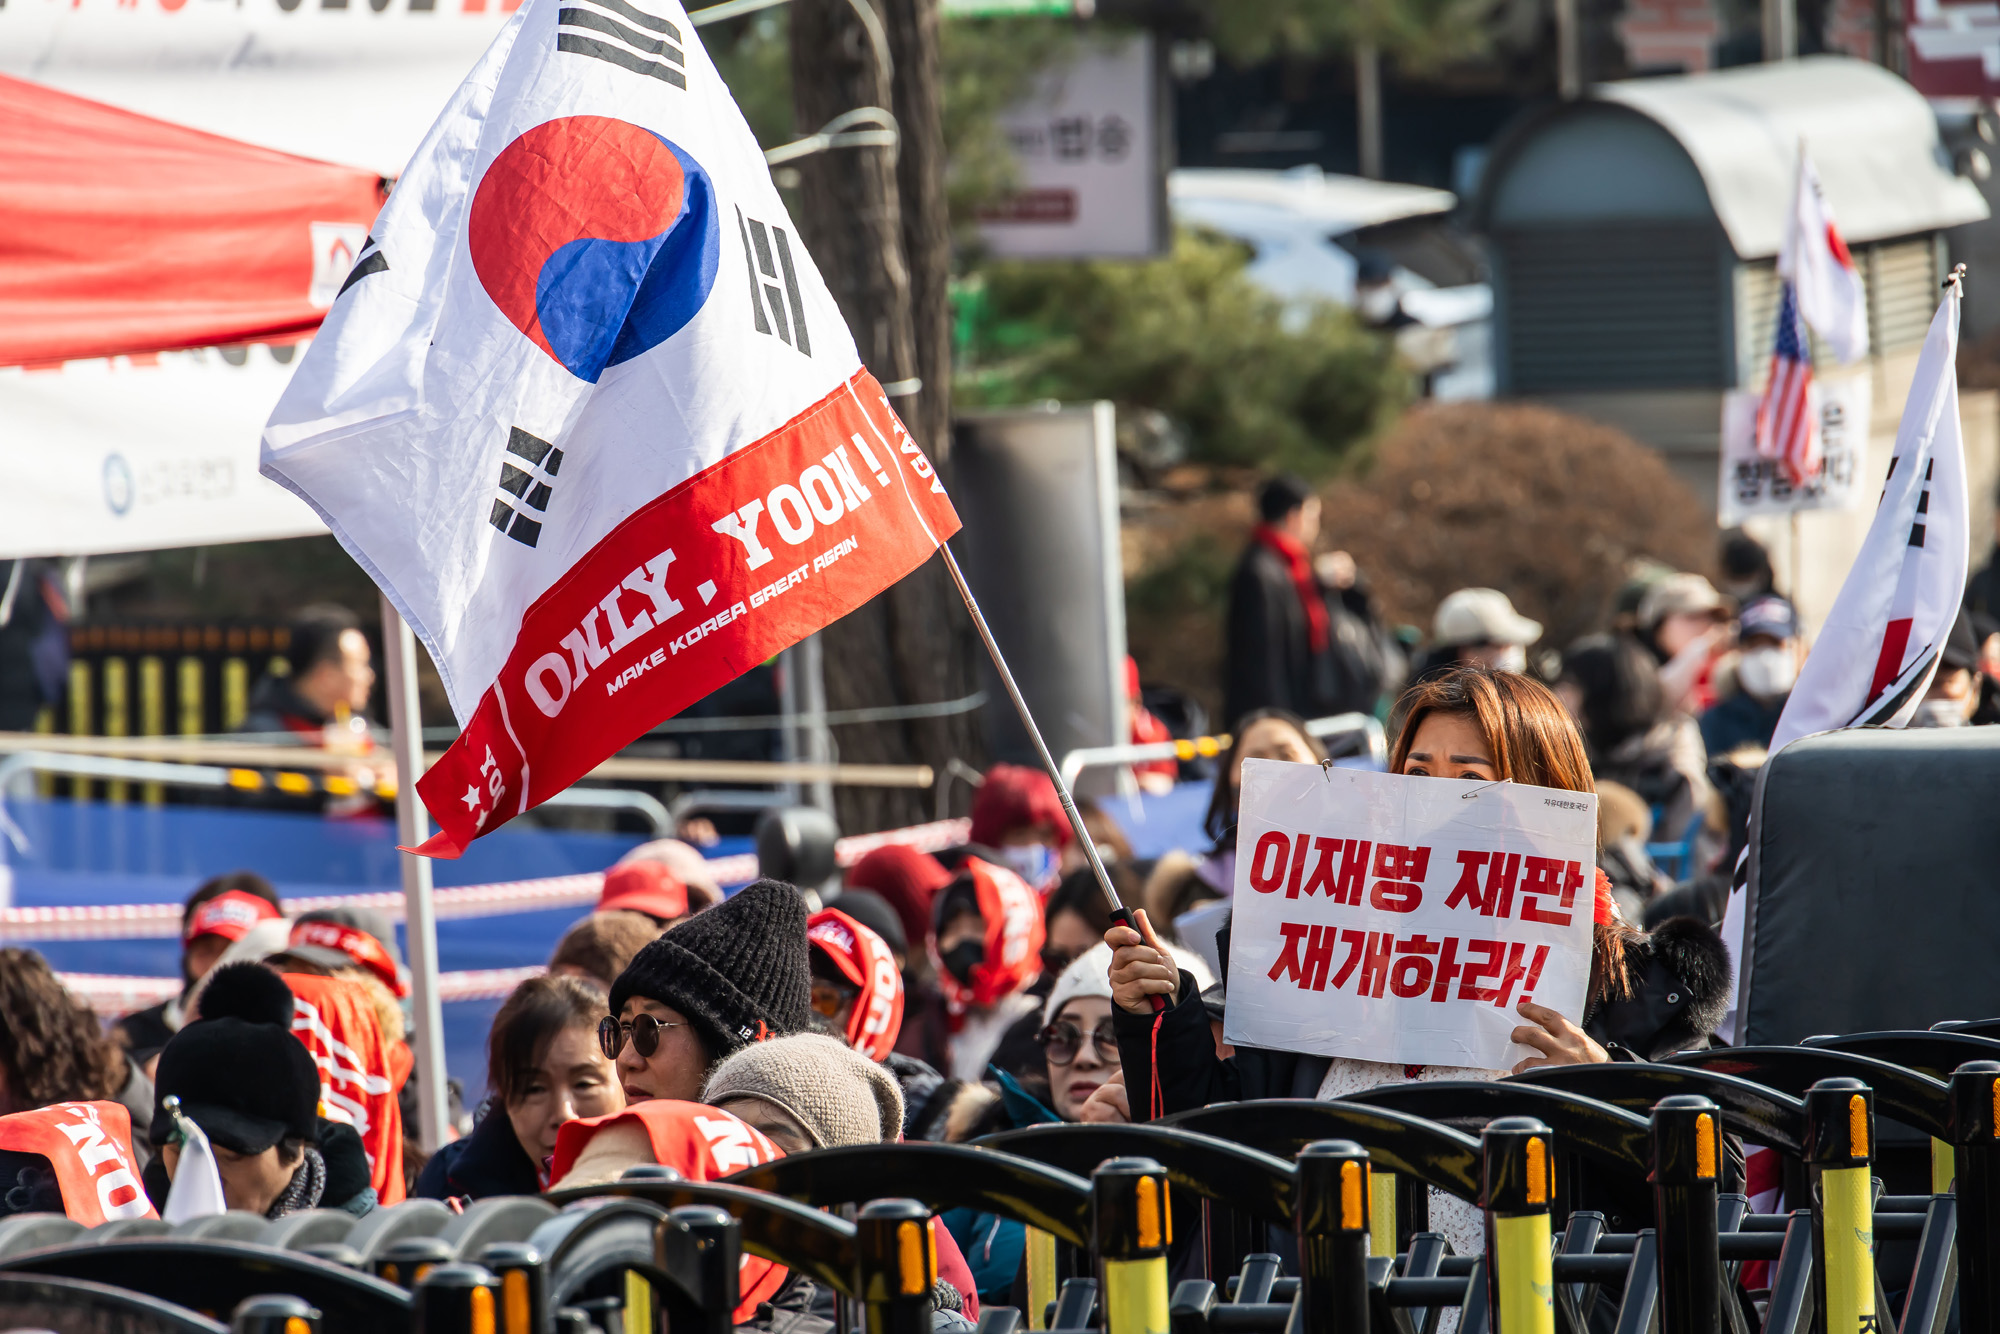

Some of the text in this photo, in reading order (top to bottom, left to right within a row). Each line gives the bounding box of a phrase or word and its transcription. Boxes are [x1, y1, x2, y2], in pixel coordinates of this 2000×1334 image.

[606, 535, 859, 696] MAKE KOREA GREAT AGAIN
[1544, 799, 1589, 811] 자유대한호국단
[1250, 830, 1585, 927] 이재명 재판
[1267, 921, 1551, 1008] 재개하라!
